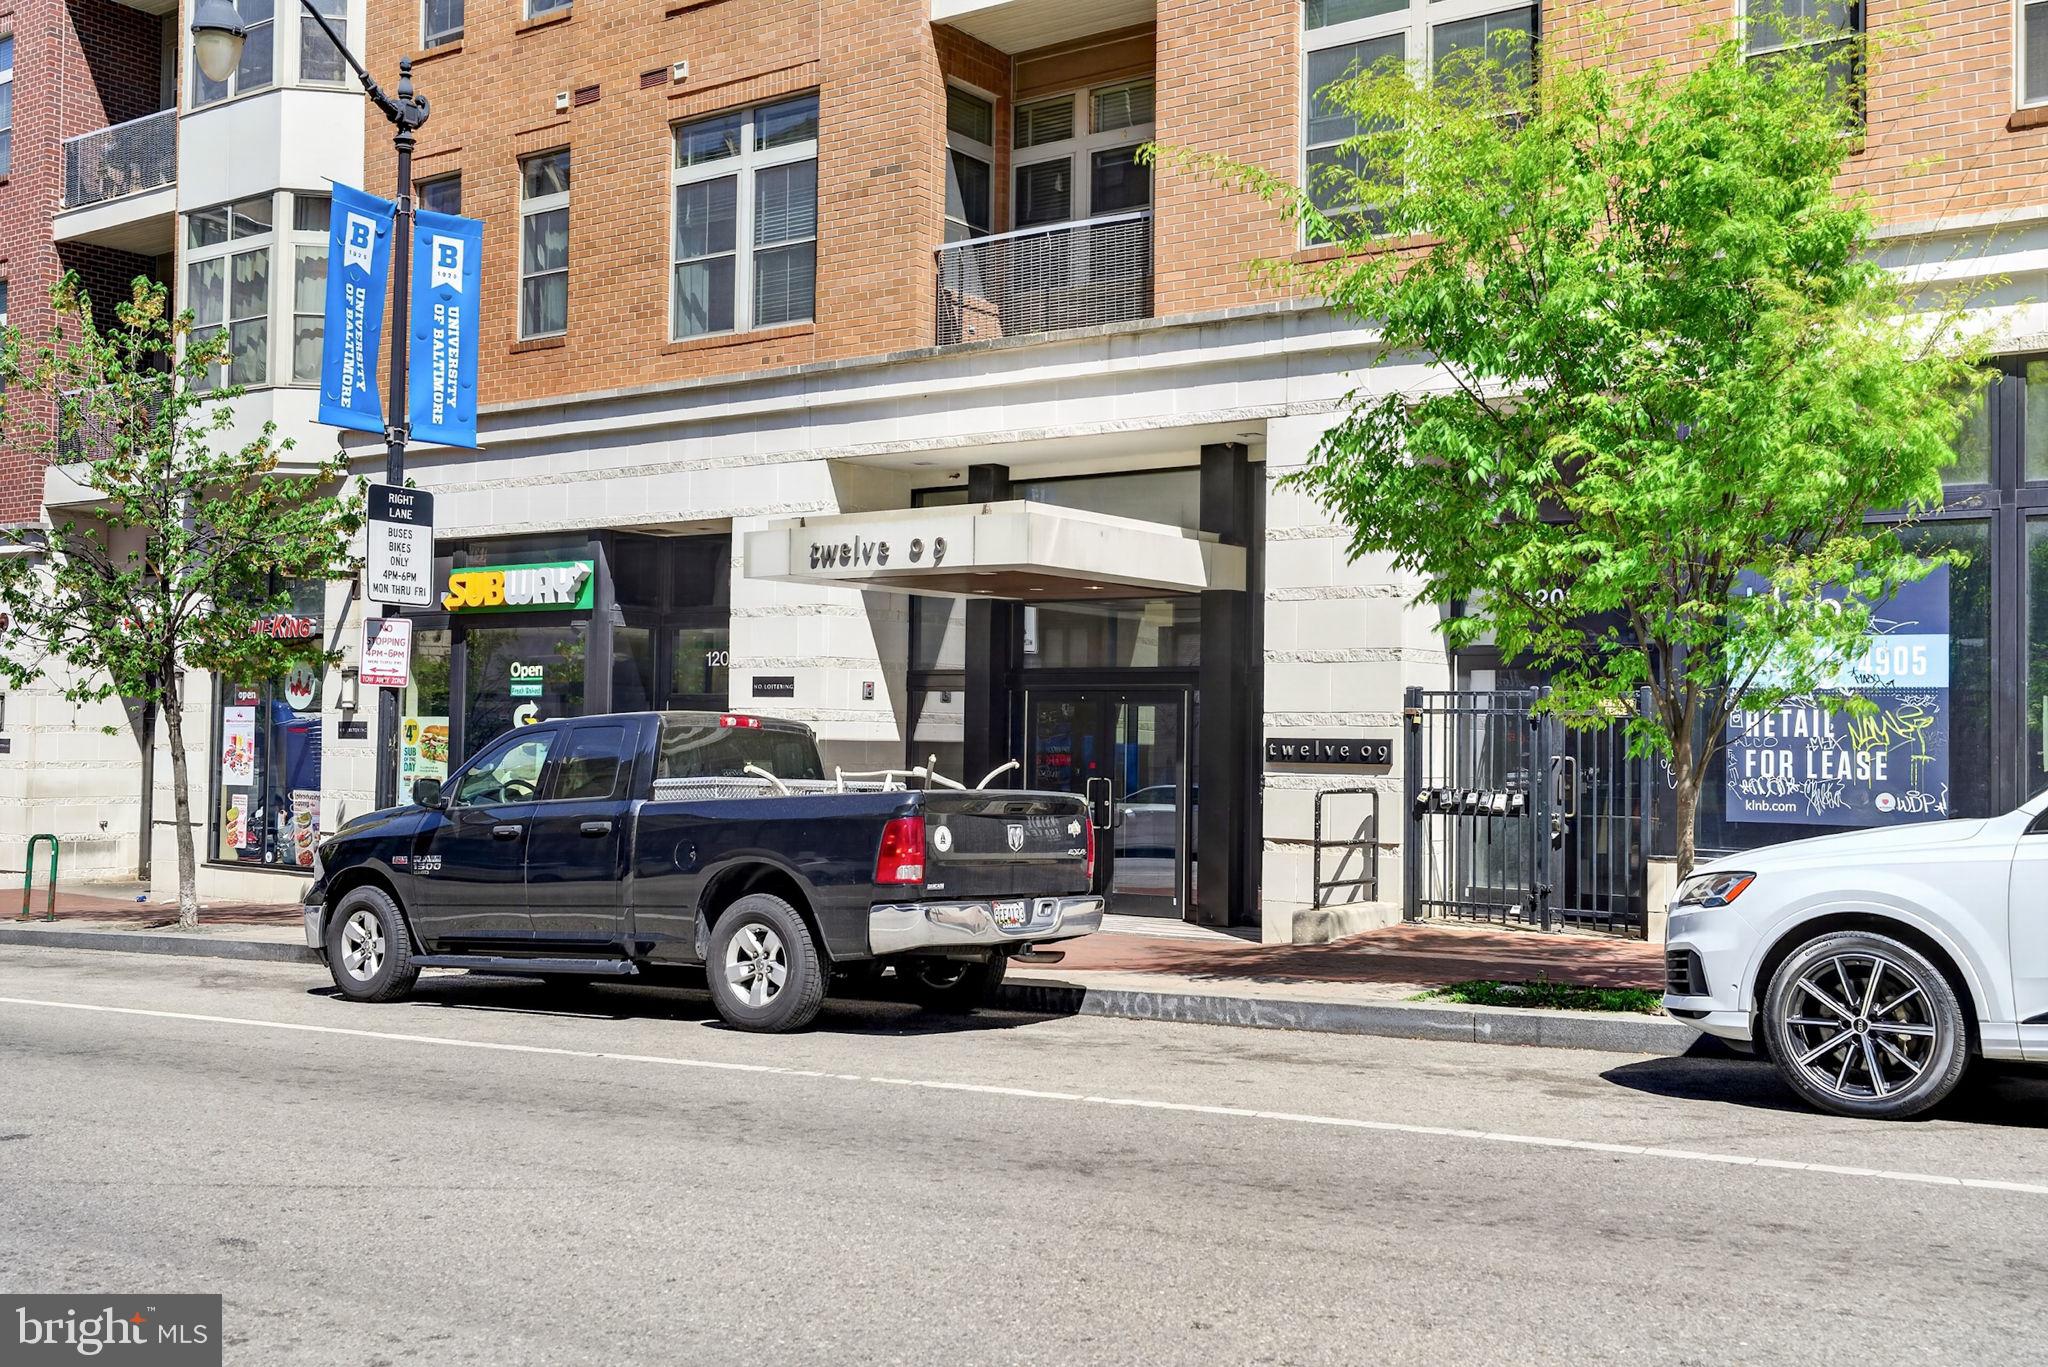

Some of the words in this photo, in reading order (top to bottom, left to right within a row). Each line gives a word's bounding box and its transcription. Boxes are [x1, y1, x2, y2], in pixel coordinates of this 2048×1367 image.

[351, 222, 370, 249] B
[438, 244, 458, 269] B
[345, 283, 354, 306] OF
[433, 303, 445, 324] OF
[356, 288, 366, 393] UNIVERSITY
[341, 310, 354, 408] BALTIMORE
[447, 306, 459, 408] UNIVERSITY
[432, 329, 445, 424] BALTIMORE
[388, 493, 414, 506] RIGHT
[389, 509, 413, 520] LANE
[388, 527, 413, 540] BUSES
[389, 542, 411, 553] BIKES
[809, 535, 890, 569] twelve
[390, 556, 409, 567] ONLY
[382, 570, 417, 582] 4PM-6PM
[373, 582, 389, 594] MON
[392, 583, 411, 596] THRU
[414, 586, 426, 597] FRI
[441, 562, 592, 611] SUBWAY
[380, 624, 393, 633] NO
[367, 637, 406, 647] STOPPING
[366, 649, 405, 658] 4PM-6PM
[705, 651, 728, 666] 120
[510, 662, 543, 679] Open
[238, 690, 256, 700] open
[1746, 709, 1835, 737] RETAIL
[404, 747, 416, 756] SUB
[1268, 740, 1350, 758] twelve
[403, 763, 416, 772] DAY
[1745, 750, 1793, 778] FOR
[1806, 750, 1888, 780] LEASE
[1745, 800, 1797, 812] klnb.com
[413, 862, 442, 870] 1500
